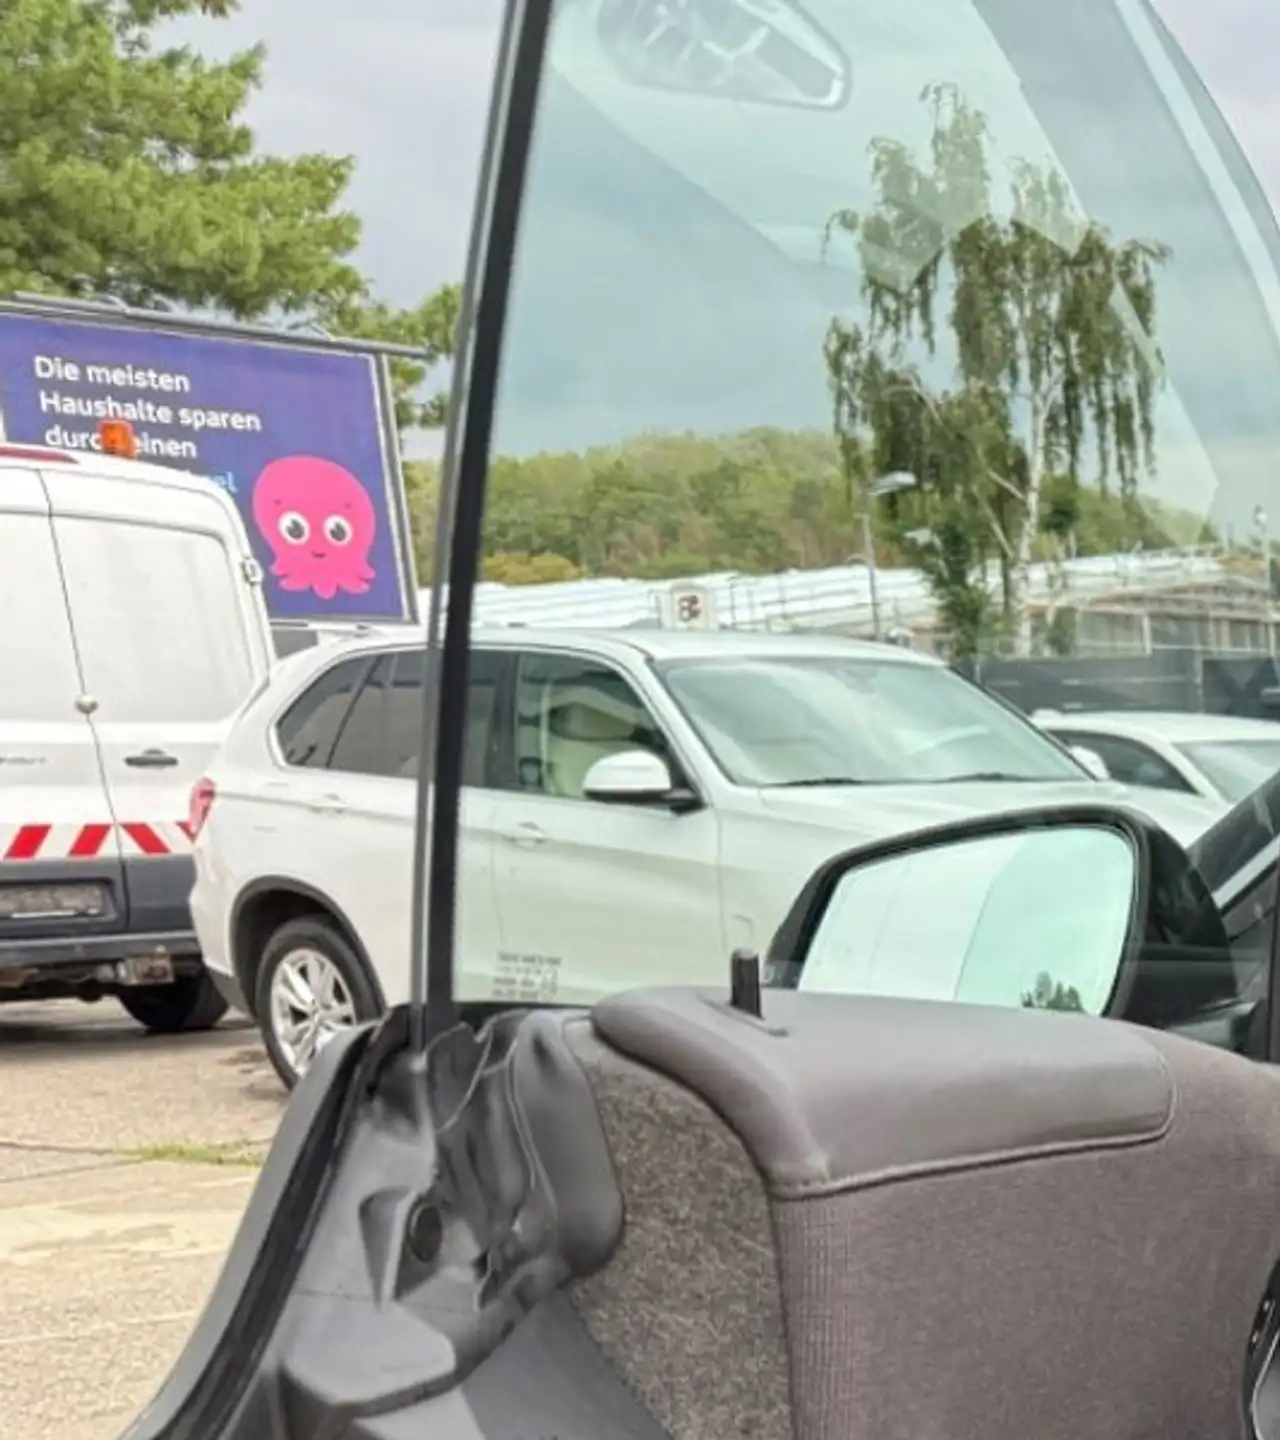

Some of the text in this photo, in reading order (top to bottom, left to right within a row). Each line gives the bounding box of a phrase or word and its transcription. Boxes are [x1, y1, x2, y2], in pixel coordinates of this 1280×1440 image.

[34, 355, 190, 392] Die meisten
[39, 389, 262, 431] Haushalte sparen
[44, 424, 102, 450] durc
